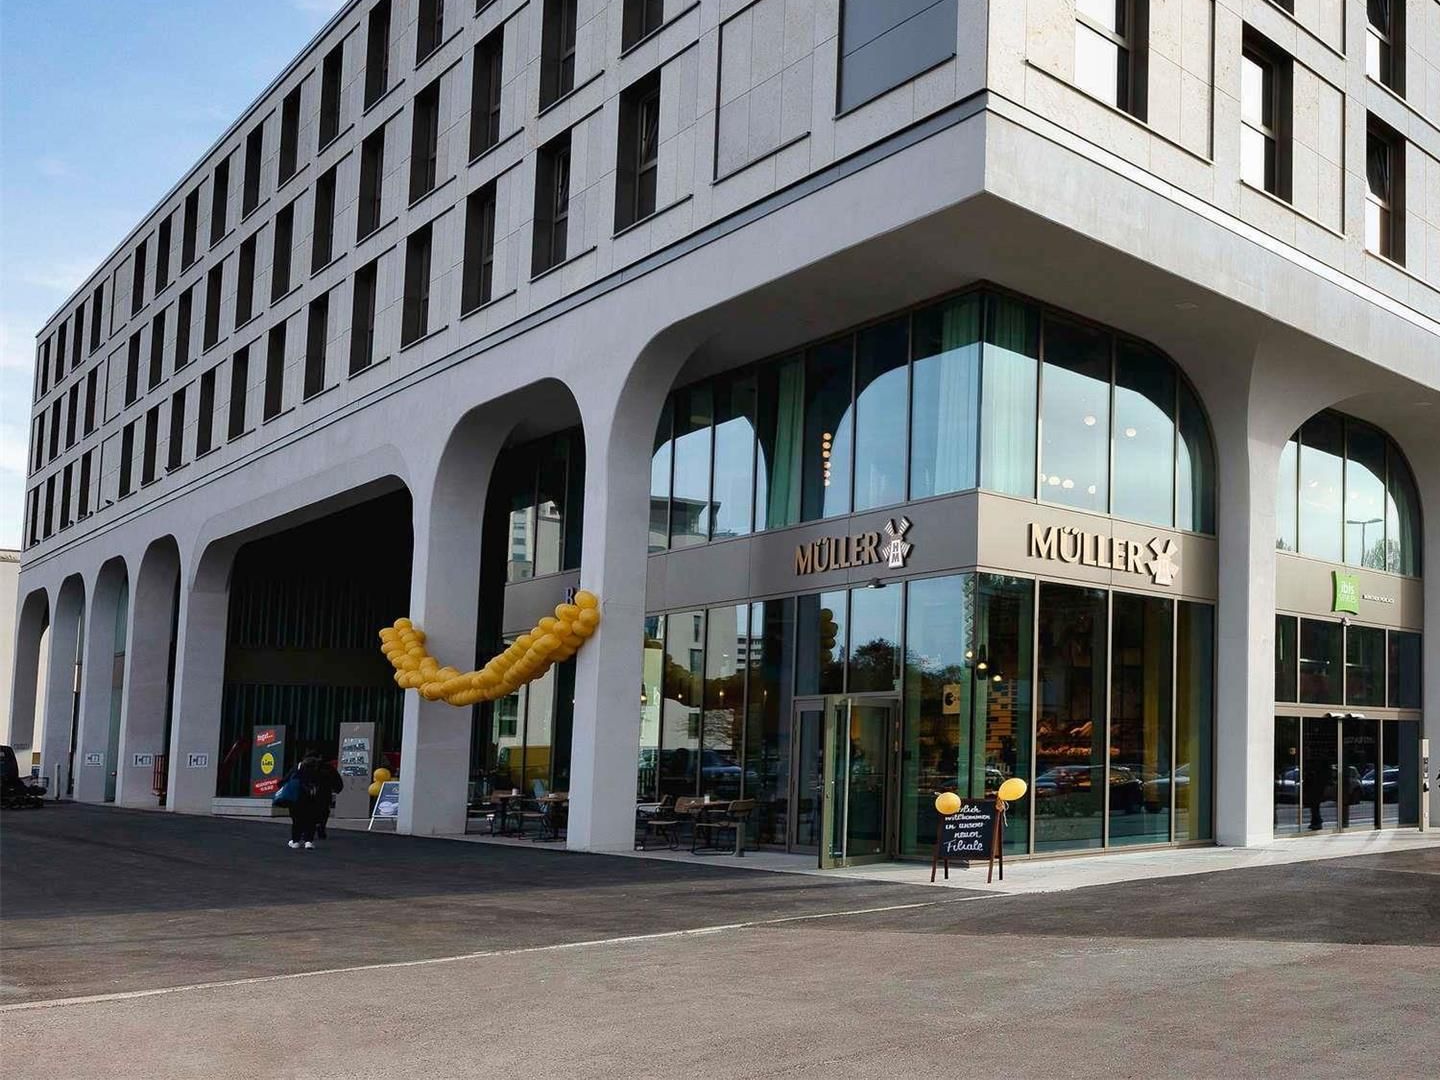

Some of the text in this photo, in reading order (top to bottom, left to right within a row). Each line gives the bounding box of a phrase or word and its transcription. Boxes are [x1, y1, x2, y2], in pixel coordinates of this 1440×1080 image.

[794, 531, 881, 576] MÜLLER
[1028, 522, 1146, 575] MÜLLER
[1341, 580, 1355, 595] ibis
[944, 840, 983, 853] Filiale
